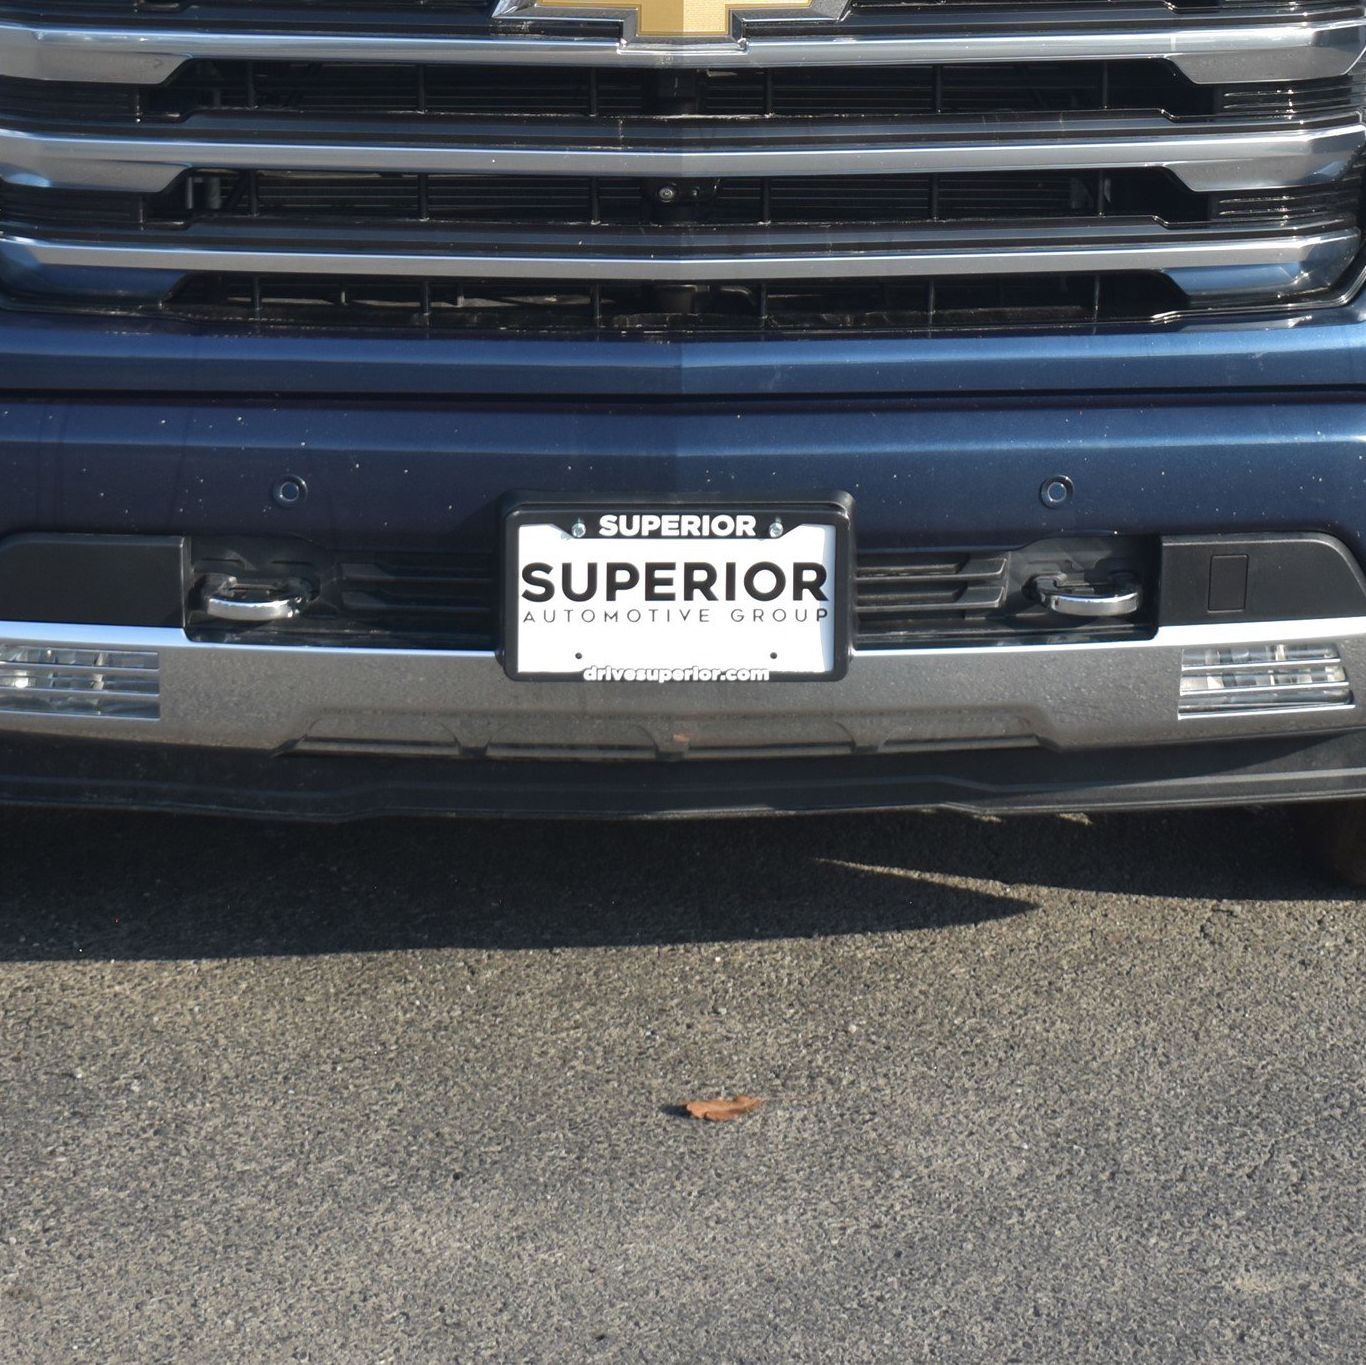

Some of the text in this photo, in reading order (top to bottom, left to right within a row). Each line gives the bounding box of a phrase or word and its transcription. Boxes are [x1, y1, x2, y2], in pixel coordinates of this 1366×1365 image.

[598, 514, 757, 537] SUPERIOR
[521, 561, 829, 603] SUPERIOR
[523, 608, 828, 623] AUTOMOTIVE GROUP
[583, 665, 770, 684] drivesuperior.com
